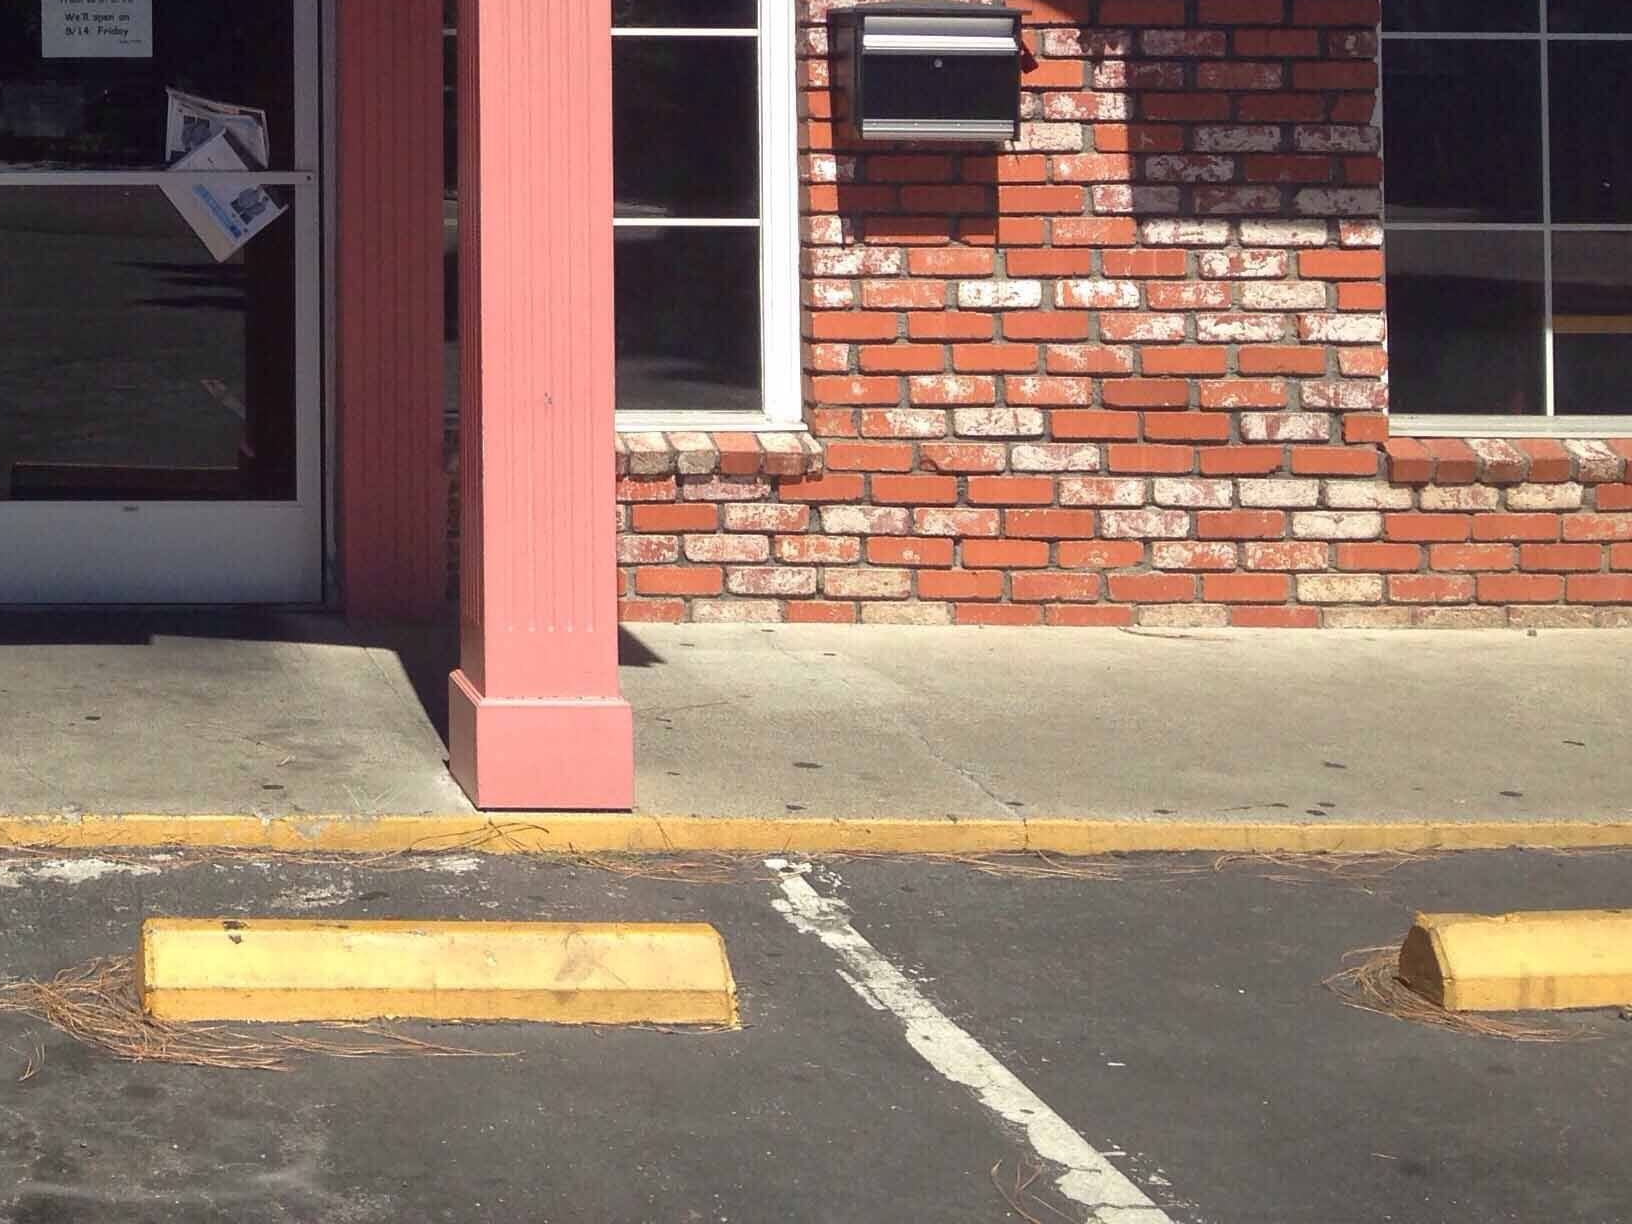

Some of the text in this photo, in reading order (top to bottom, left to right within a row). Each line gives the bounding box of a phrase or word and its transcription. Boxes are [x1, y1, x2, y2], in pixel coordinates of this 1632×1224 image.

[93, 14, 114, 24] open
[118, 14, 130, 22] on
[97, 25, 129, 38] Friday
